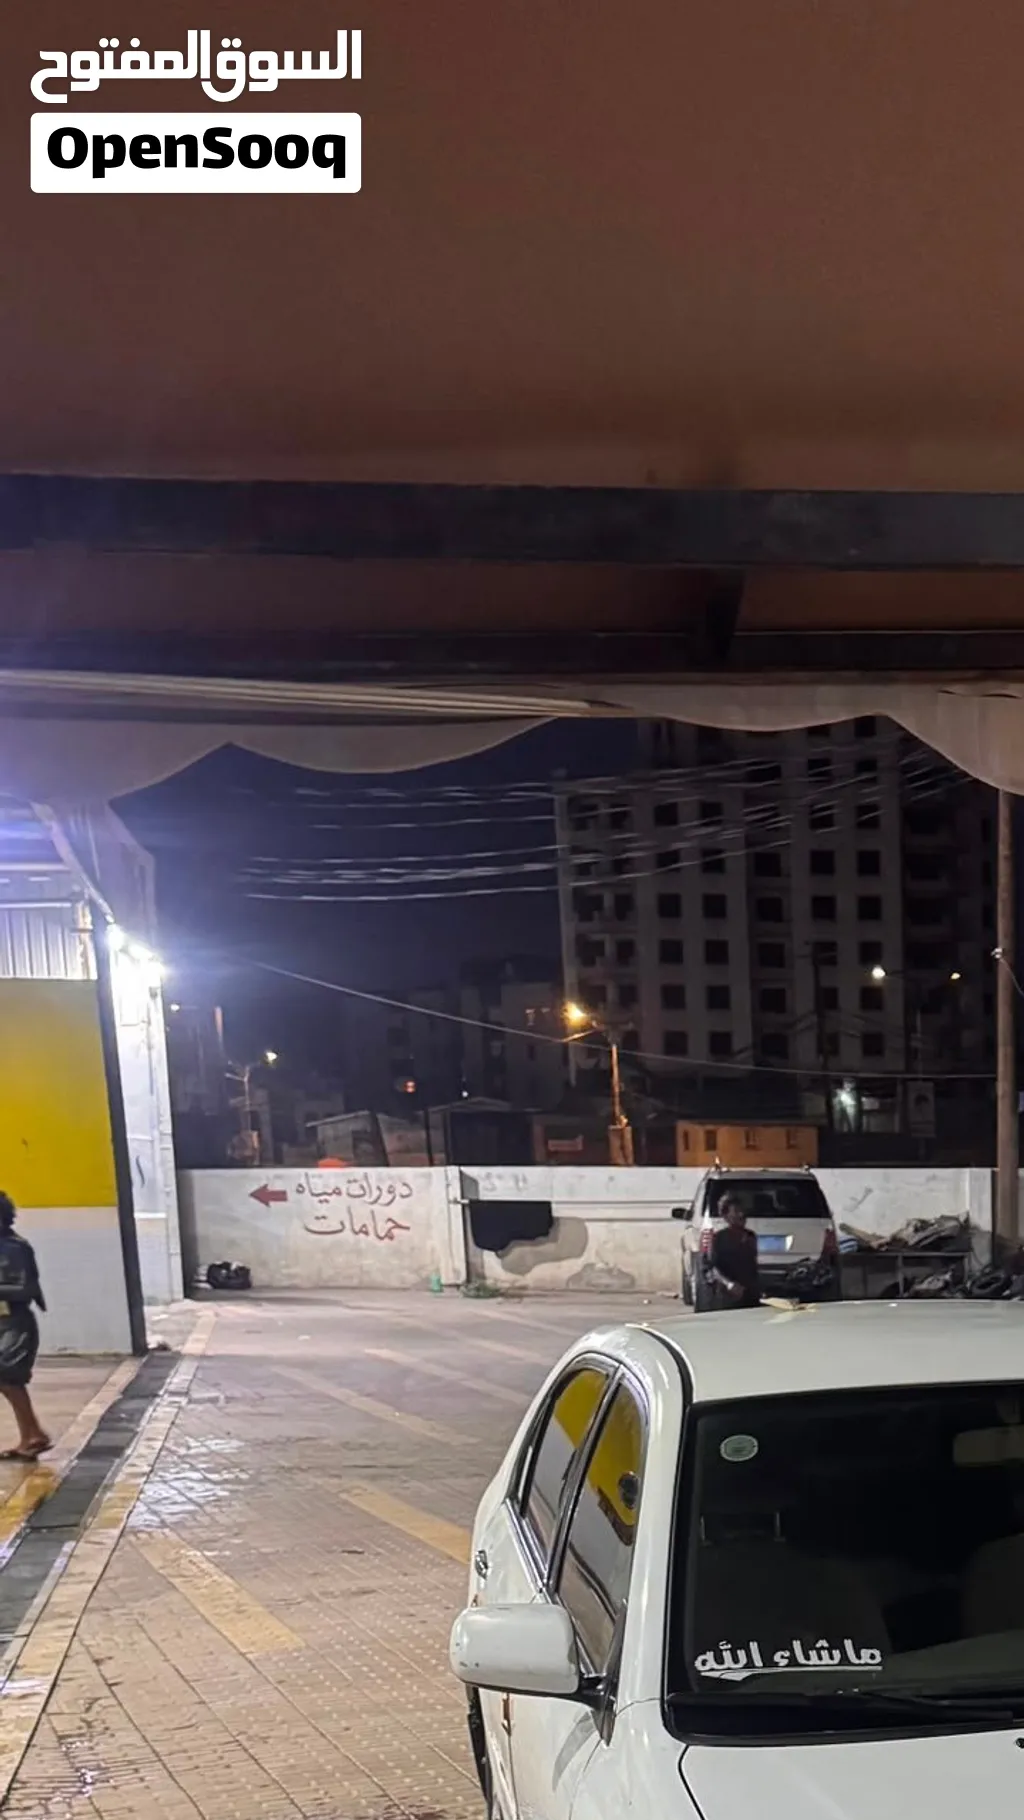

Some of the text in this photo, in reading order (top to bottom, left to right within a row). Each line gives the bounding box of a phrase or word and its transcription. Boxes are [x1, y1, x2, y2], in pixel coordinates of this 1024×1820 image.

[295, 1172, 413, 1207] دورات مياه
[303, 1206, 411, 1241] حمامات
[694, 1640, 764, 1671] الله
